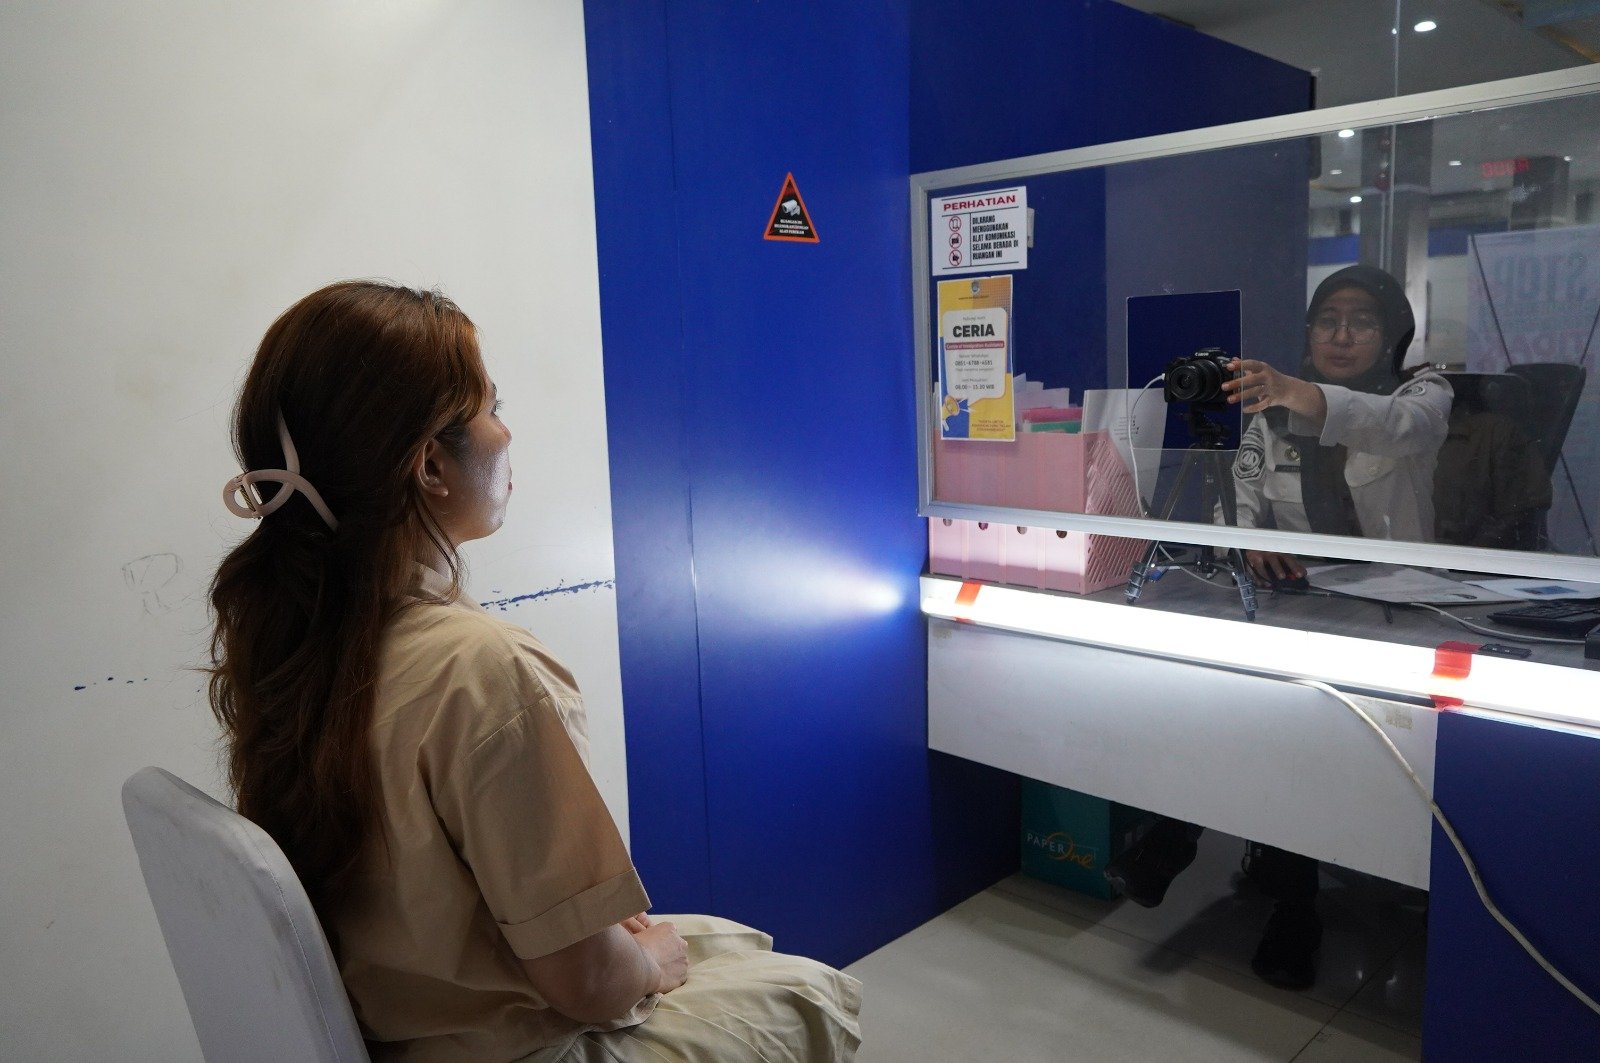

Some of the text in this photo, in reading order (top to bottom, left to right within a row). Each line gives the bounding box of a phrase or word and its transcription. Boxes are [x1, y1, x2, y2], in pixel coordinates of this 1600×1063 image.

[943, 195, 1016, 211] PERHATIAN
[972, 215, 995, 225] DILARANG
[972, 222, 1009, 233] MENGGUNAKAN
[972, 231, 1016, 242] ALAT KOMUNIKASI
[972, 239, 1019, 251] SELAMA BERADA DI
[972, 250, 1003, 260] RUANGAN INI
[952, 323, 995, 338] CERIA
[1027, 832, 1065, 854] PAPER
